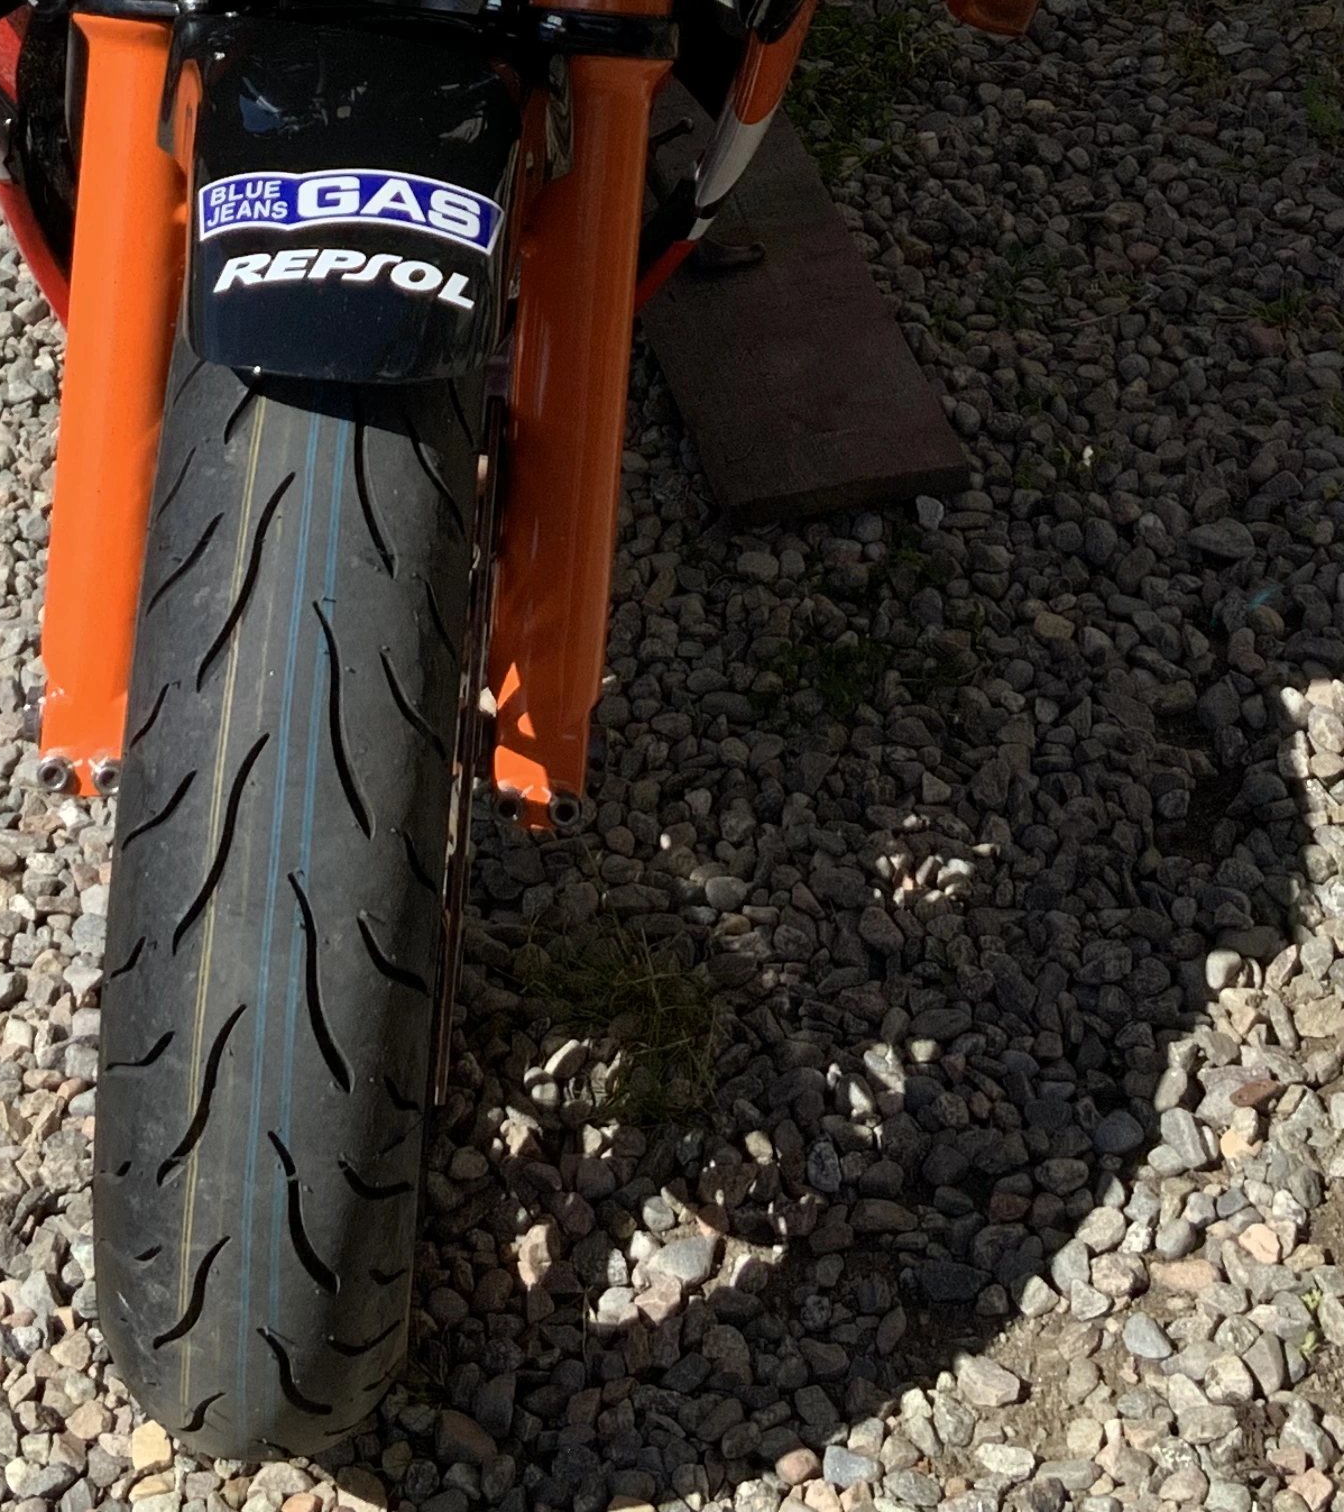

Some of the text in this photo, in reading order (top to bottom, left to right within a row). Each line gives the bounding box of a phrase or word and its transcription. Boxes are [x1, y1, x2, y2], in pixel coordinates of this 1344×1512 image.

[207, 199, 288, 226] JEANS
[211, 180, 282, 206] BLUE
[297, 176, 480, 238] GAS
[213, 248, 475, 309] REPSOL
